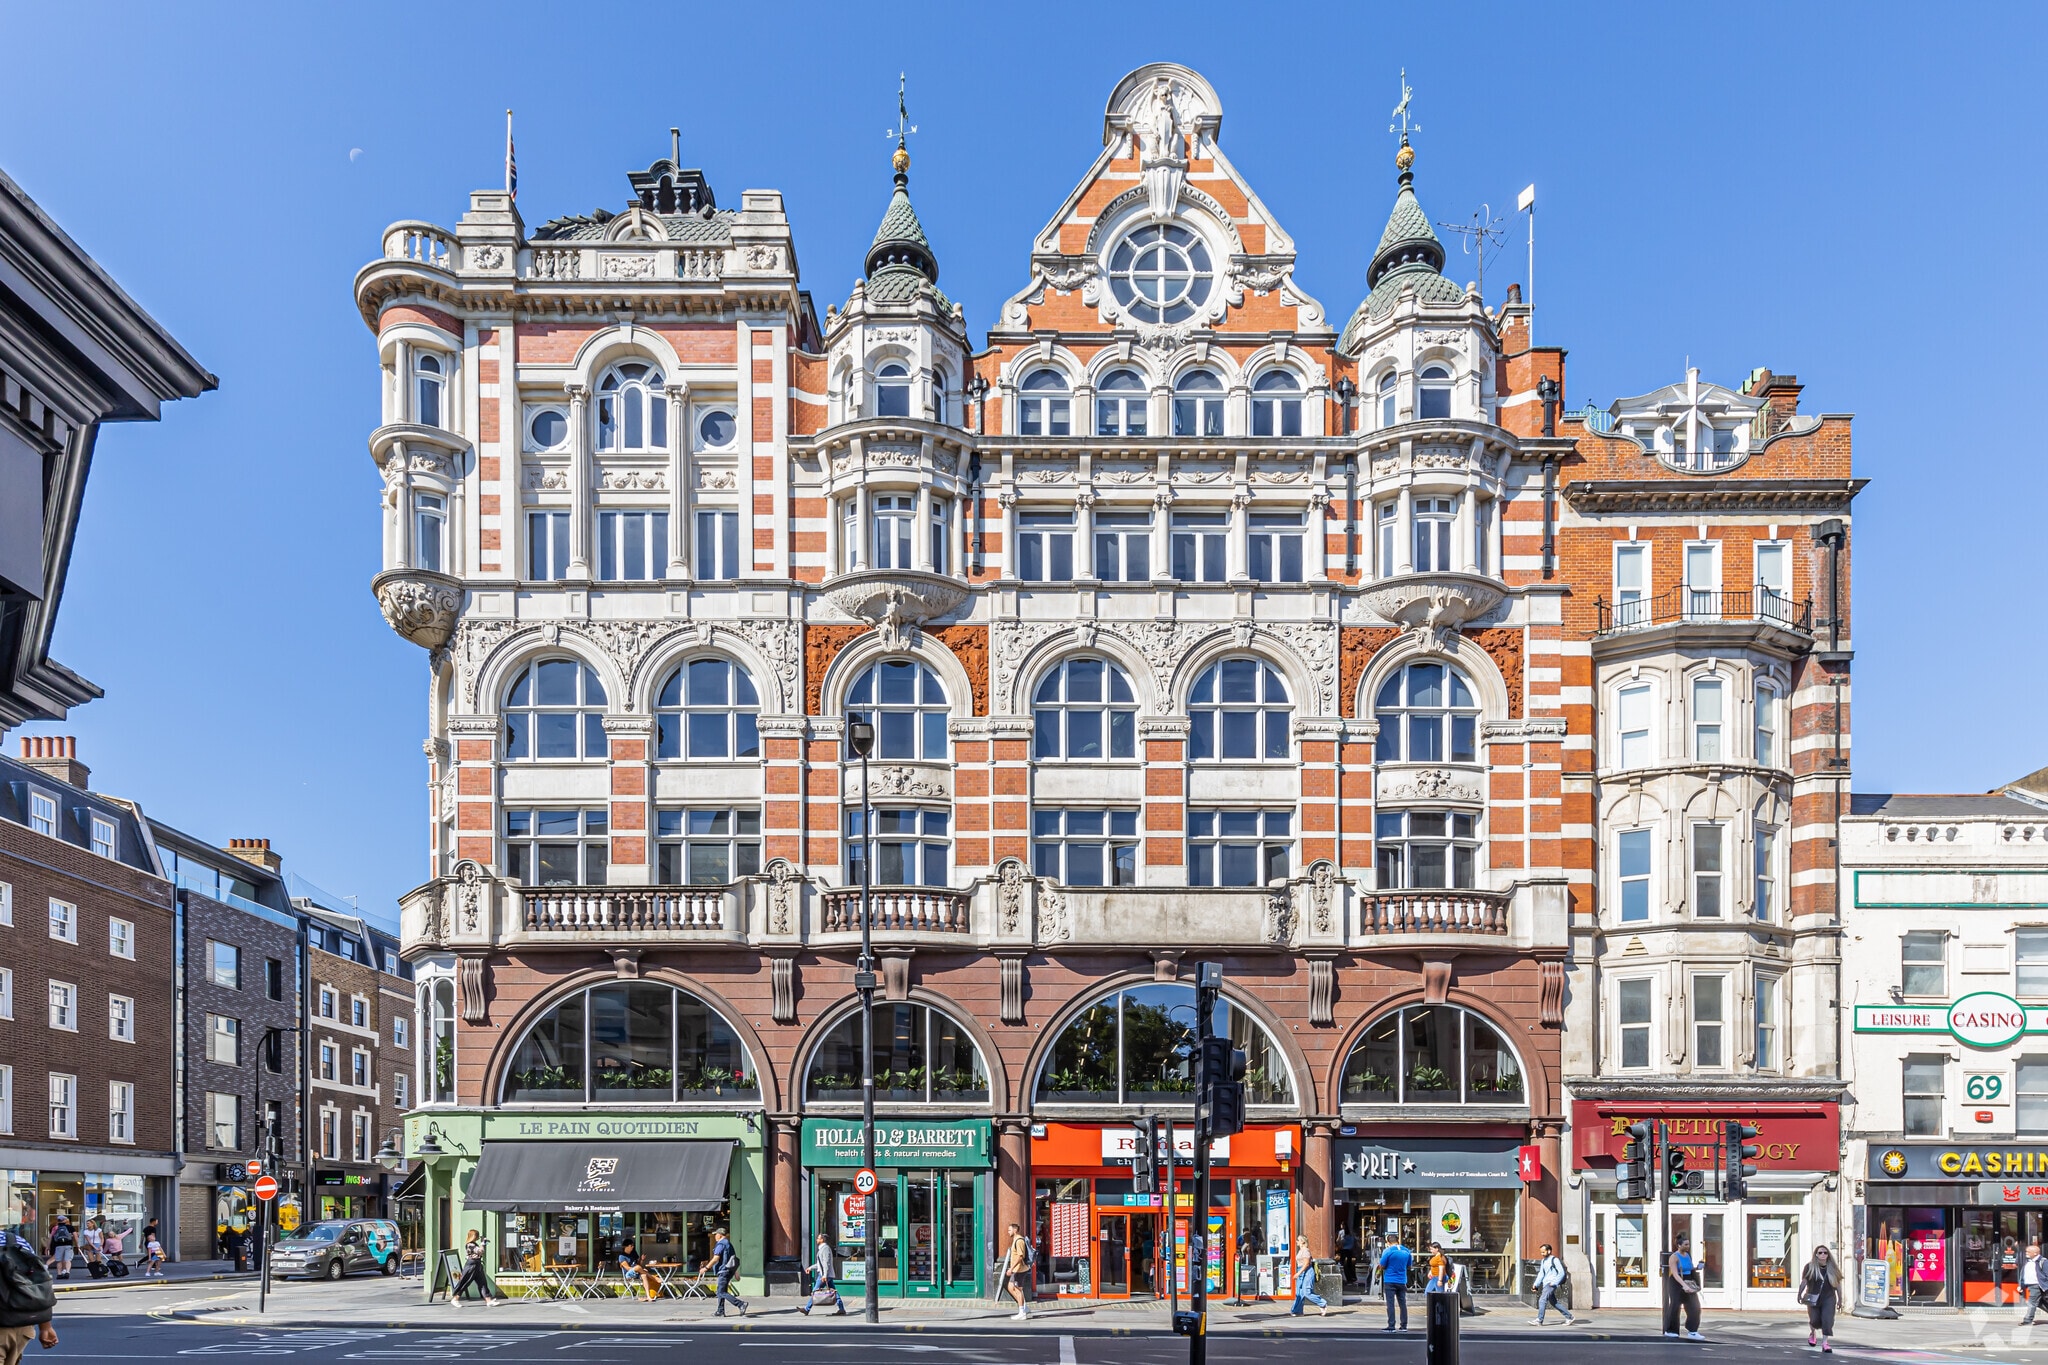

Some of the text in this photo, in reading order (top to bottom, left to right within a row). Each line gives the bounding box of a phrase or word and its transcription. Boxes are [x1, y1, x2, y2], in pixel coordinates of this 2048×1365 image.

[1872, 1013, 1931, 1026] LEISURE
[1953, 1012, 2024, 1028] CASINO
[1966, 1075, 2003, 1100] 69
[519, 1122, 699, 1135] LE PAIN QUOTIDIEN
[815, 1128, 977, 1148] HOLLAD & BARRETT
[835, 1149, 859, 1158] health
[884, 1150, 892, 1158] &
[893, 1149, 920, 1158] natural
[922, 1149, 957, 1158] remedies
[1360, 1152, 1400, 1177] PRET
[857, 1176, 874, 1187] 20
[1269, 1198, 1287, 1206] COOL
[1270, 1192, 1287, 1200] KEEP
